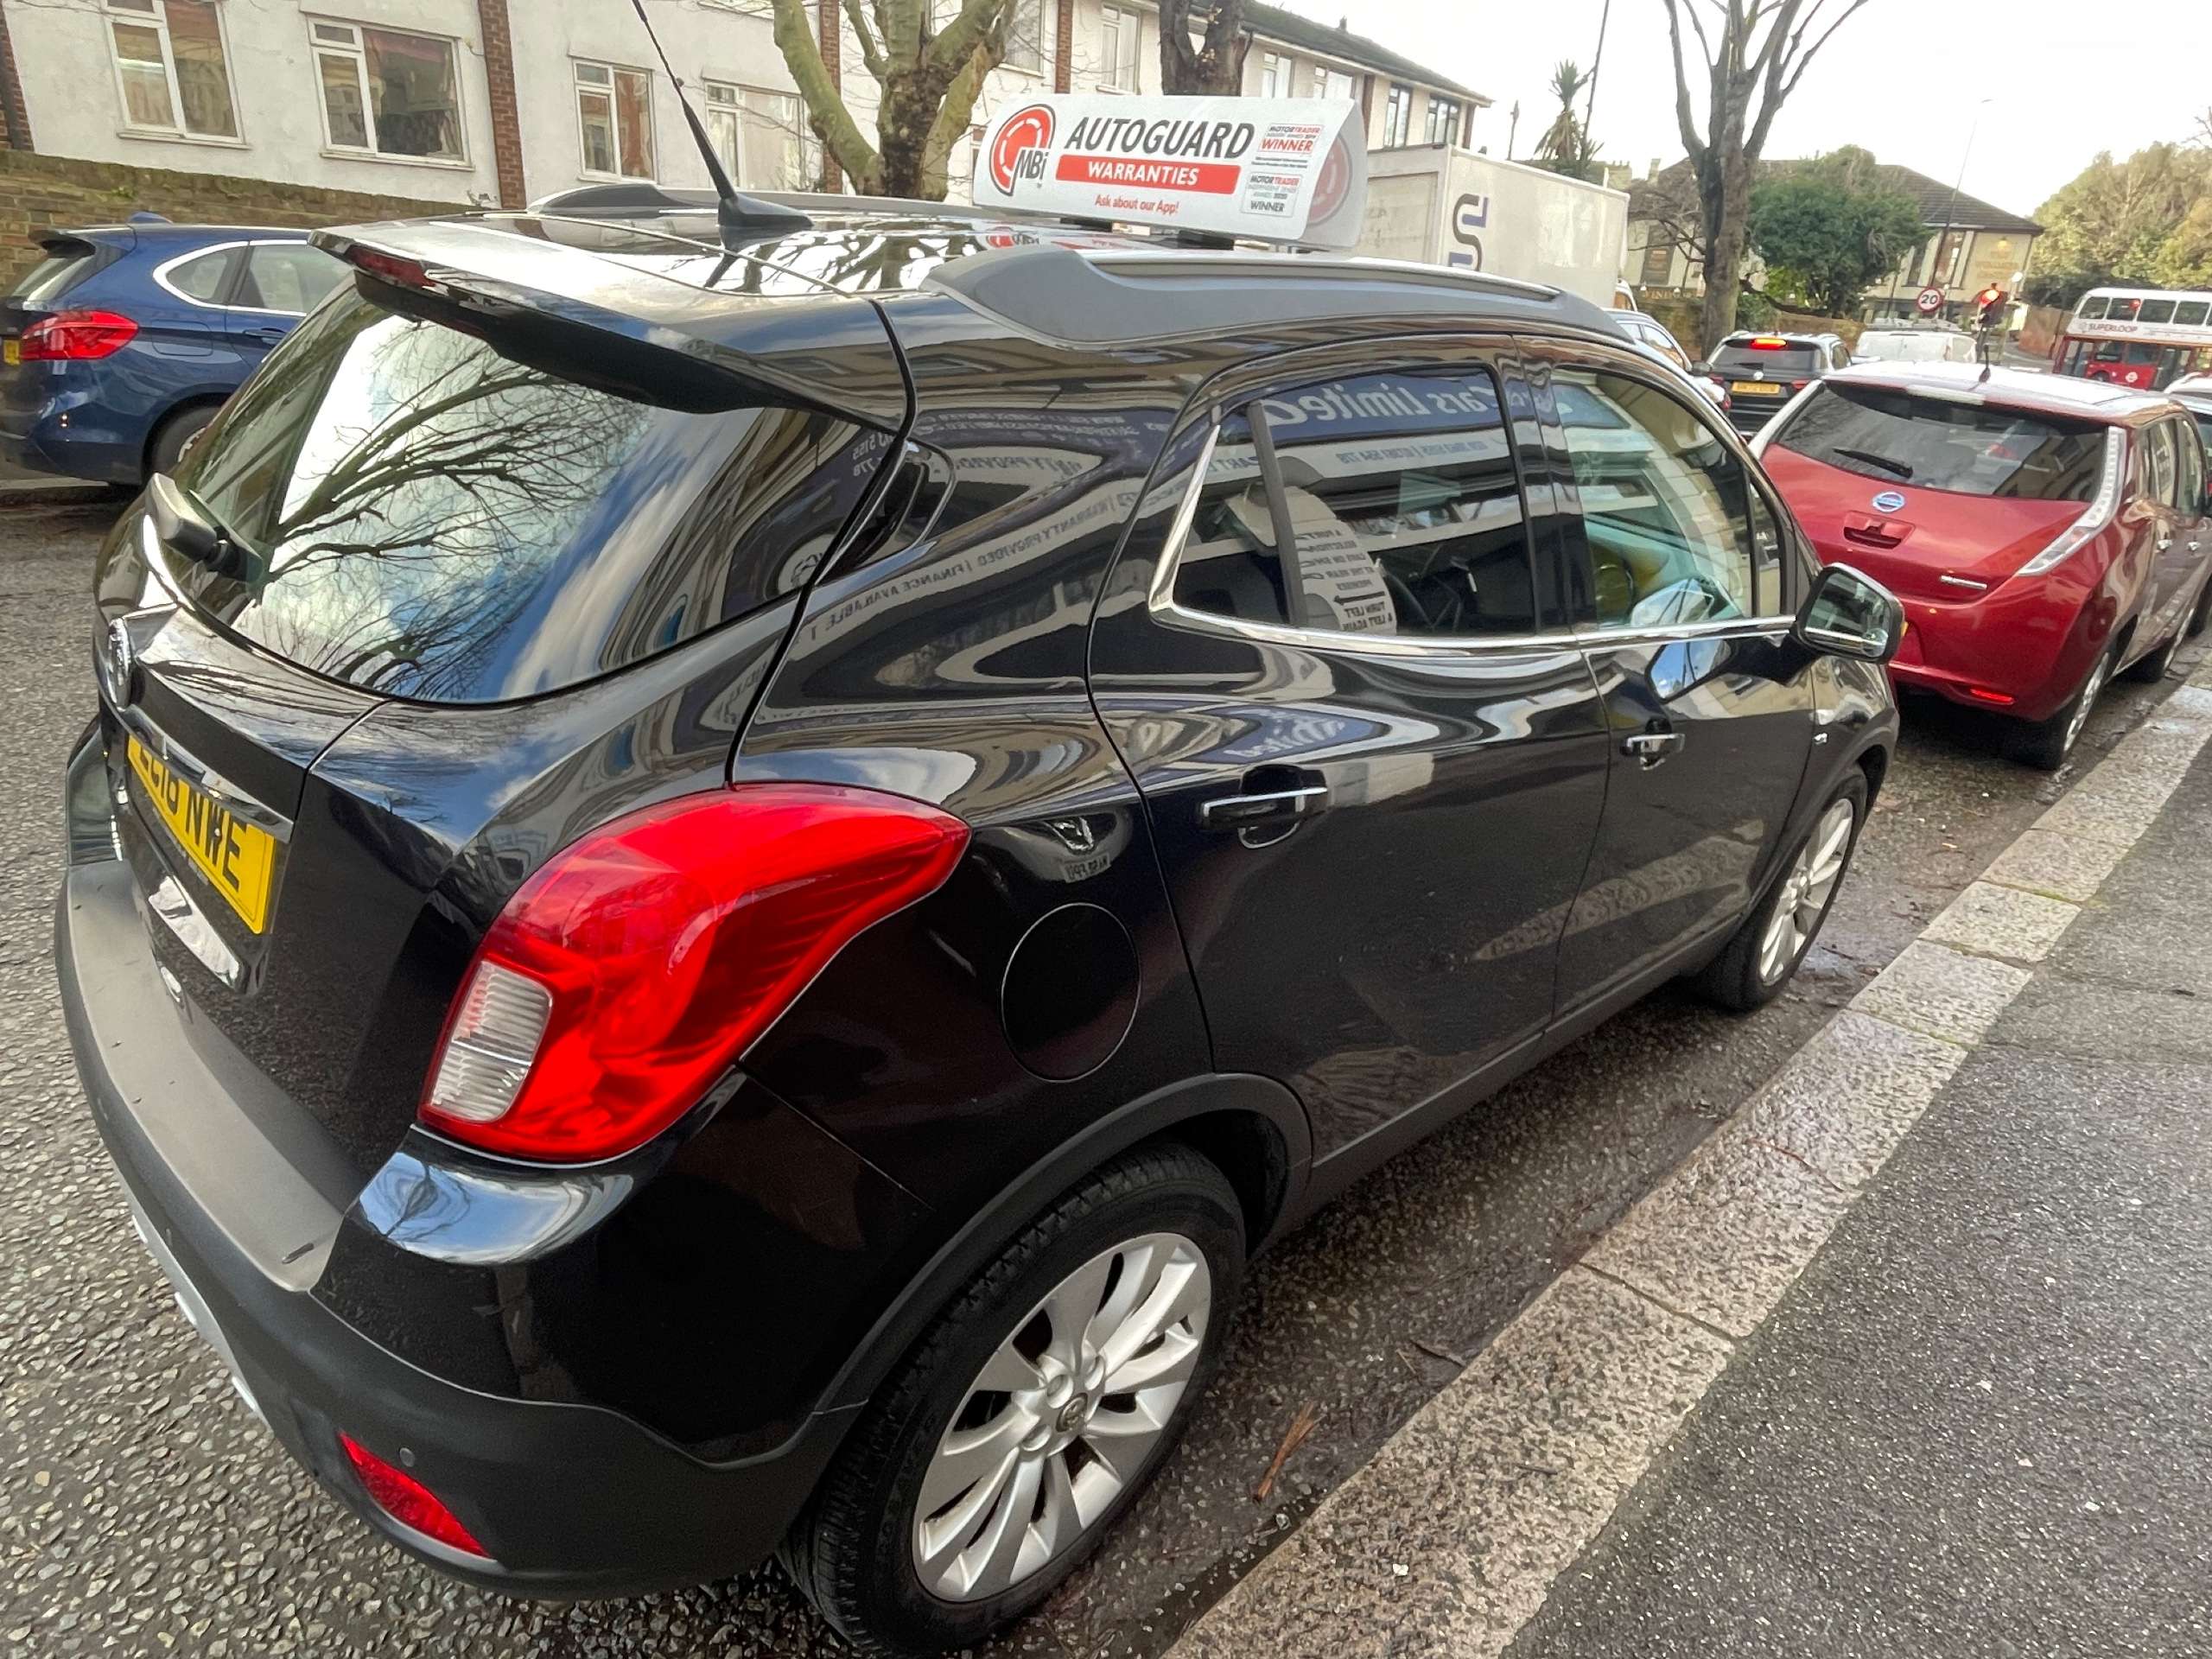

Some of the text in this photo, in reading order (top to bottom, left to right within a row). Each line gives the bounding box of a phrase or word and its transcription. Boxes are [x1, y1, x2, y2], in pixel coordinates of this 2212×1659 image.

[1064, 117, 1255, 161] AUTOGUARD
[1262, 137, 1314, 154] WINNER
[1015, 146, 1050, 181] MBi
[1087, 161, 1199, 187] WARRANTIES
[1094, 194, 1180, 215] Ask about our App!
[1250, 200, 1285, 213] WINNER
[1921, 294, 1938, 305] 20
[2088, 322, 2139, 334] SUPERLOOP
